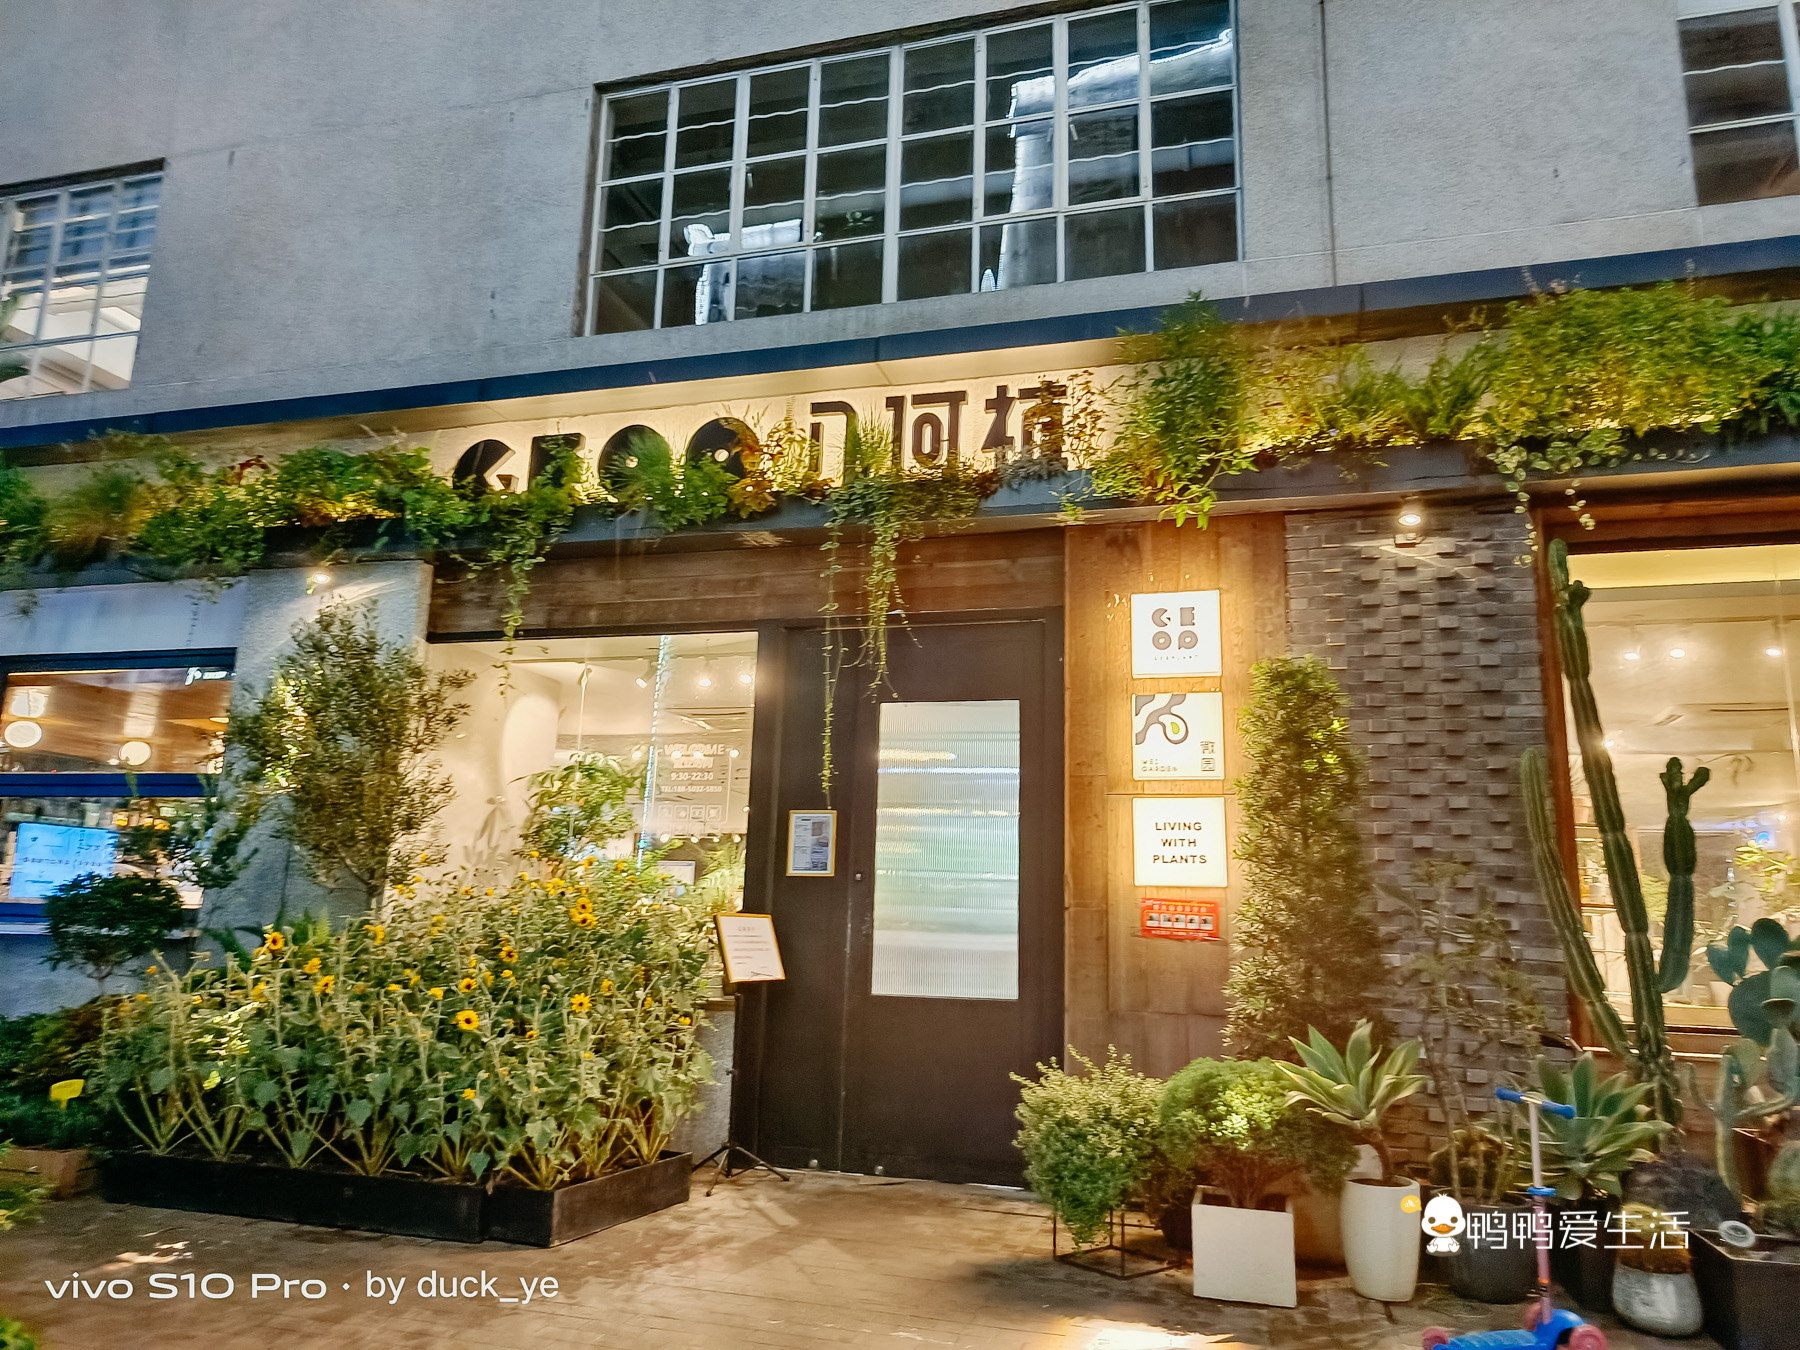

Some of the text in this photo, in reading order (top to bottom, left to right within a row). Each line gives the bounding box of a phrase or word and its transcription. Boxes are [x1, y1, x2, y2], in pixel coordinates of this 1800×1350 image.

[664, 743, 725, 755] WELCOME
[1155, 822, 1202, 831] LIVING
[1161, 838, 1197, 847] WITH
[1153, 854, 1207, 864] PLANTS
